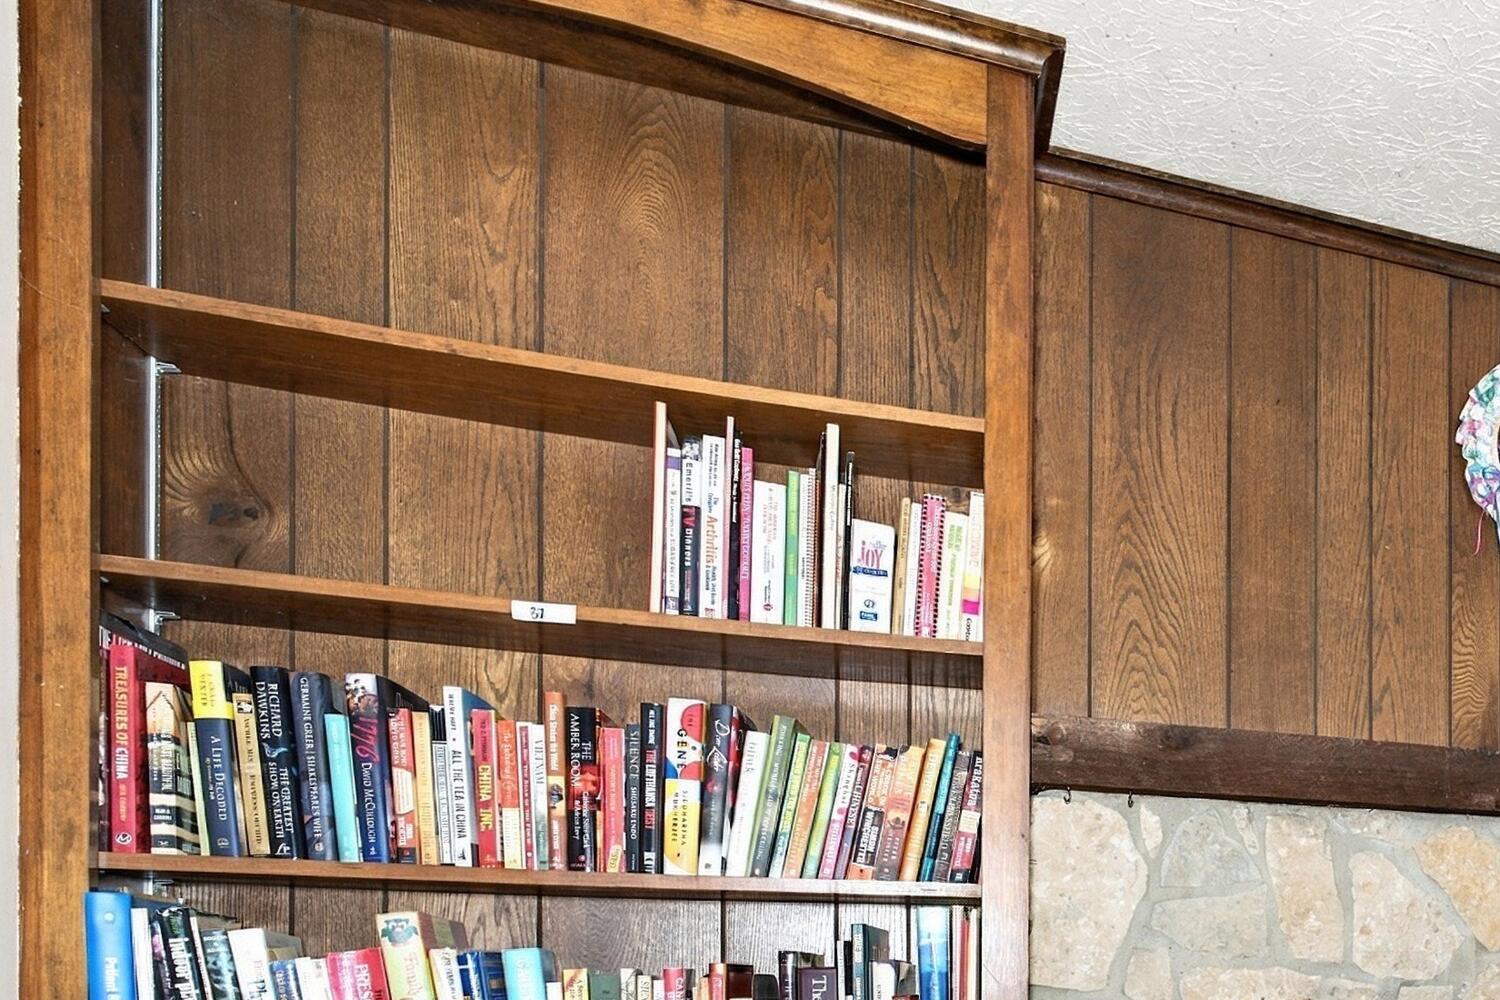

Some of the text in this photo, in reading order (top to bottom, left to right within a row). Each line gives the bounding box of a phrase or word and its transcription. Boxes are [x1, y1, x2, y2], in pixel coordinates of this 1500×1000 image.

[684, 507, 694, 527] TV
[684, 528, 692, 566] Dinners
[705, 515, 718, 563] Arthritis
[115, 666, 128, 731] TREASURES
[256, 681, 282, 739] RICHARD DAWKINS
[116, 732, 129, 746] OF
[300, 677, 322, 838] GERMAINE GREER SHAKESPEARE'S WIFE
[351, 717, 380, 763] 1776
[570, 713, 591, 788] THE AMBER ROOM
[629, 730, 639, 780] SILENCE
[645, 749, 656, 763] THE
[677, 729, 687, 768] GENE
[116, 748, 129, 779] CHINA
[211, 736, 228, 821] A LIFE DECODED
[361, 762, 373, 787] DAVID
[535, 740, 544, 784] VIETNAM
[268, 761, 294, 839] THE GREATEST SHOW ON EARTH
[452, 750, 467, 839] ALL THE TEA IN CHINA
[479, 765, 492, 831] CHINA INC.
[645, 764, 655, 807] LUFTHANSA
[848, 785, 862, 824] CHINESE
[644, 808, 655, 830] HEIST
[856, 811, 874, 863] WINCHESTER
[868, 825, 880, 852] SIMON
[105, 957, 117, 992] Patient
[168, 937, 192, 980] indoor
